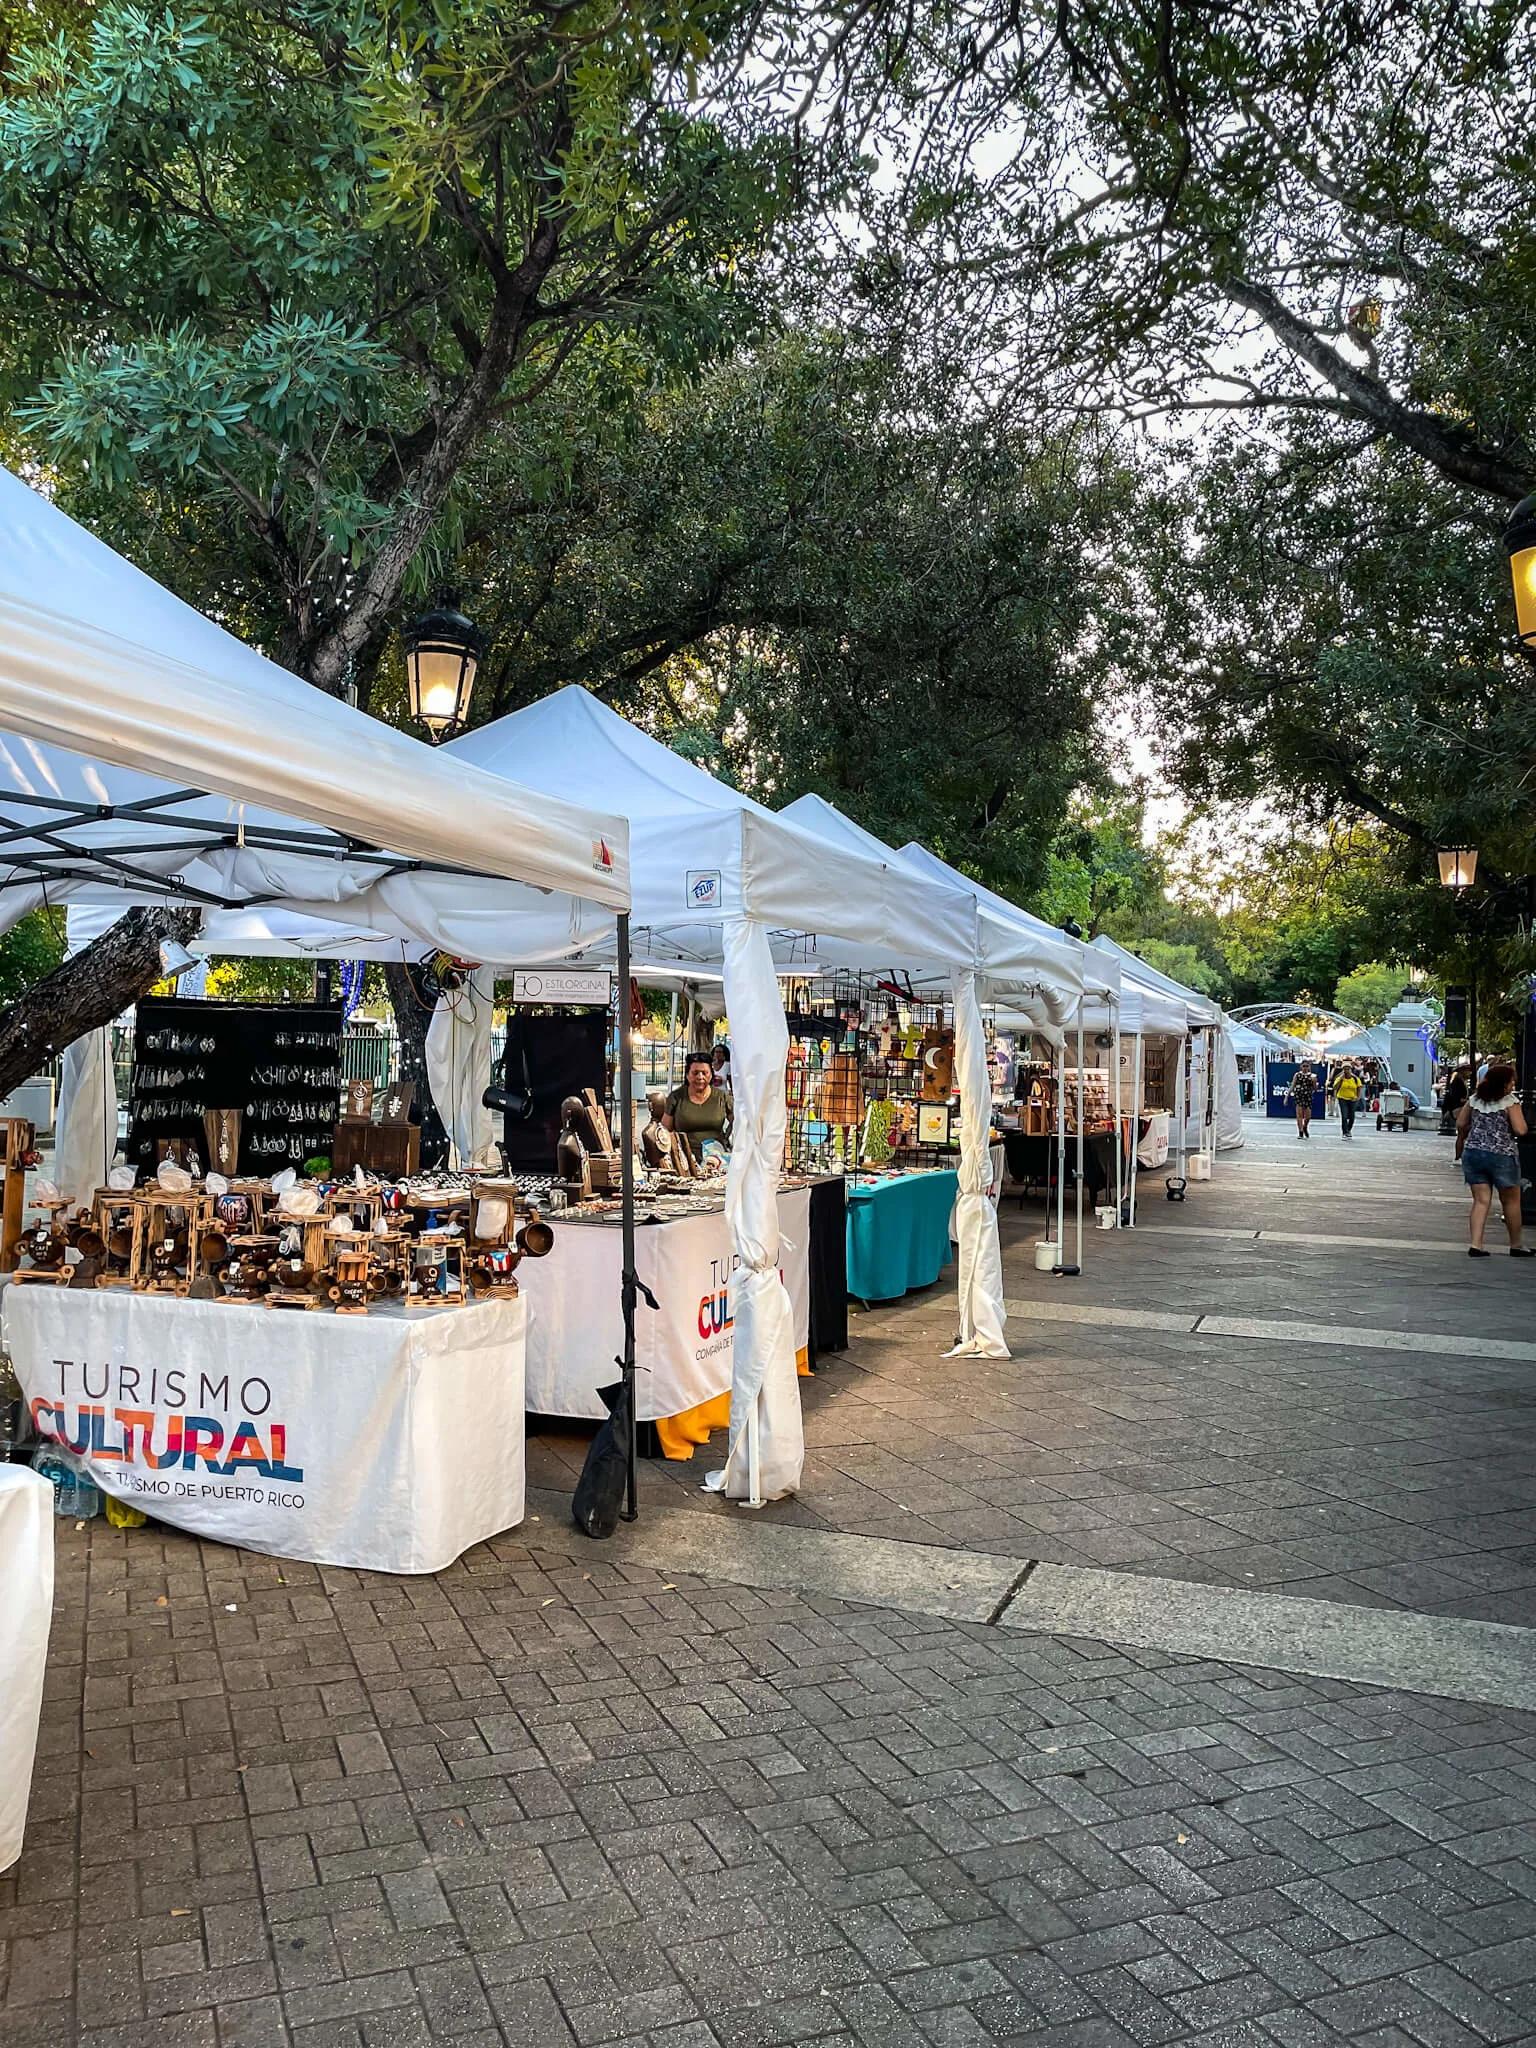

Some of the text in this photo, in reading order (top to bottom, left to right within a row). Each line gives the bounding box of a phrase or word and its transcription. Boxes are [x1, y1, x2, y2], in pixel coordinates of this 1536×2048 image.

[52, 1360, 271, 1416] TURISMO
[31, 1397, 304, 1483] CULTURAL
[174, 1482, 197, 1497] DE
[201, 1485, 265, 1504] PUERTO
[267, 1491, 305, 1509] RICO
